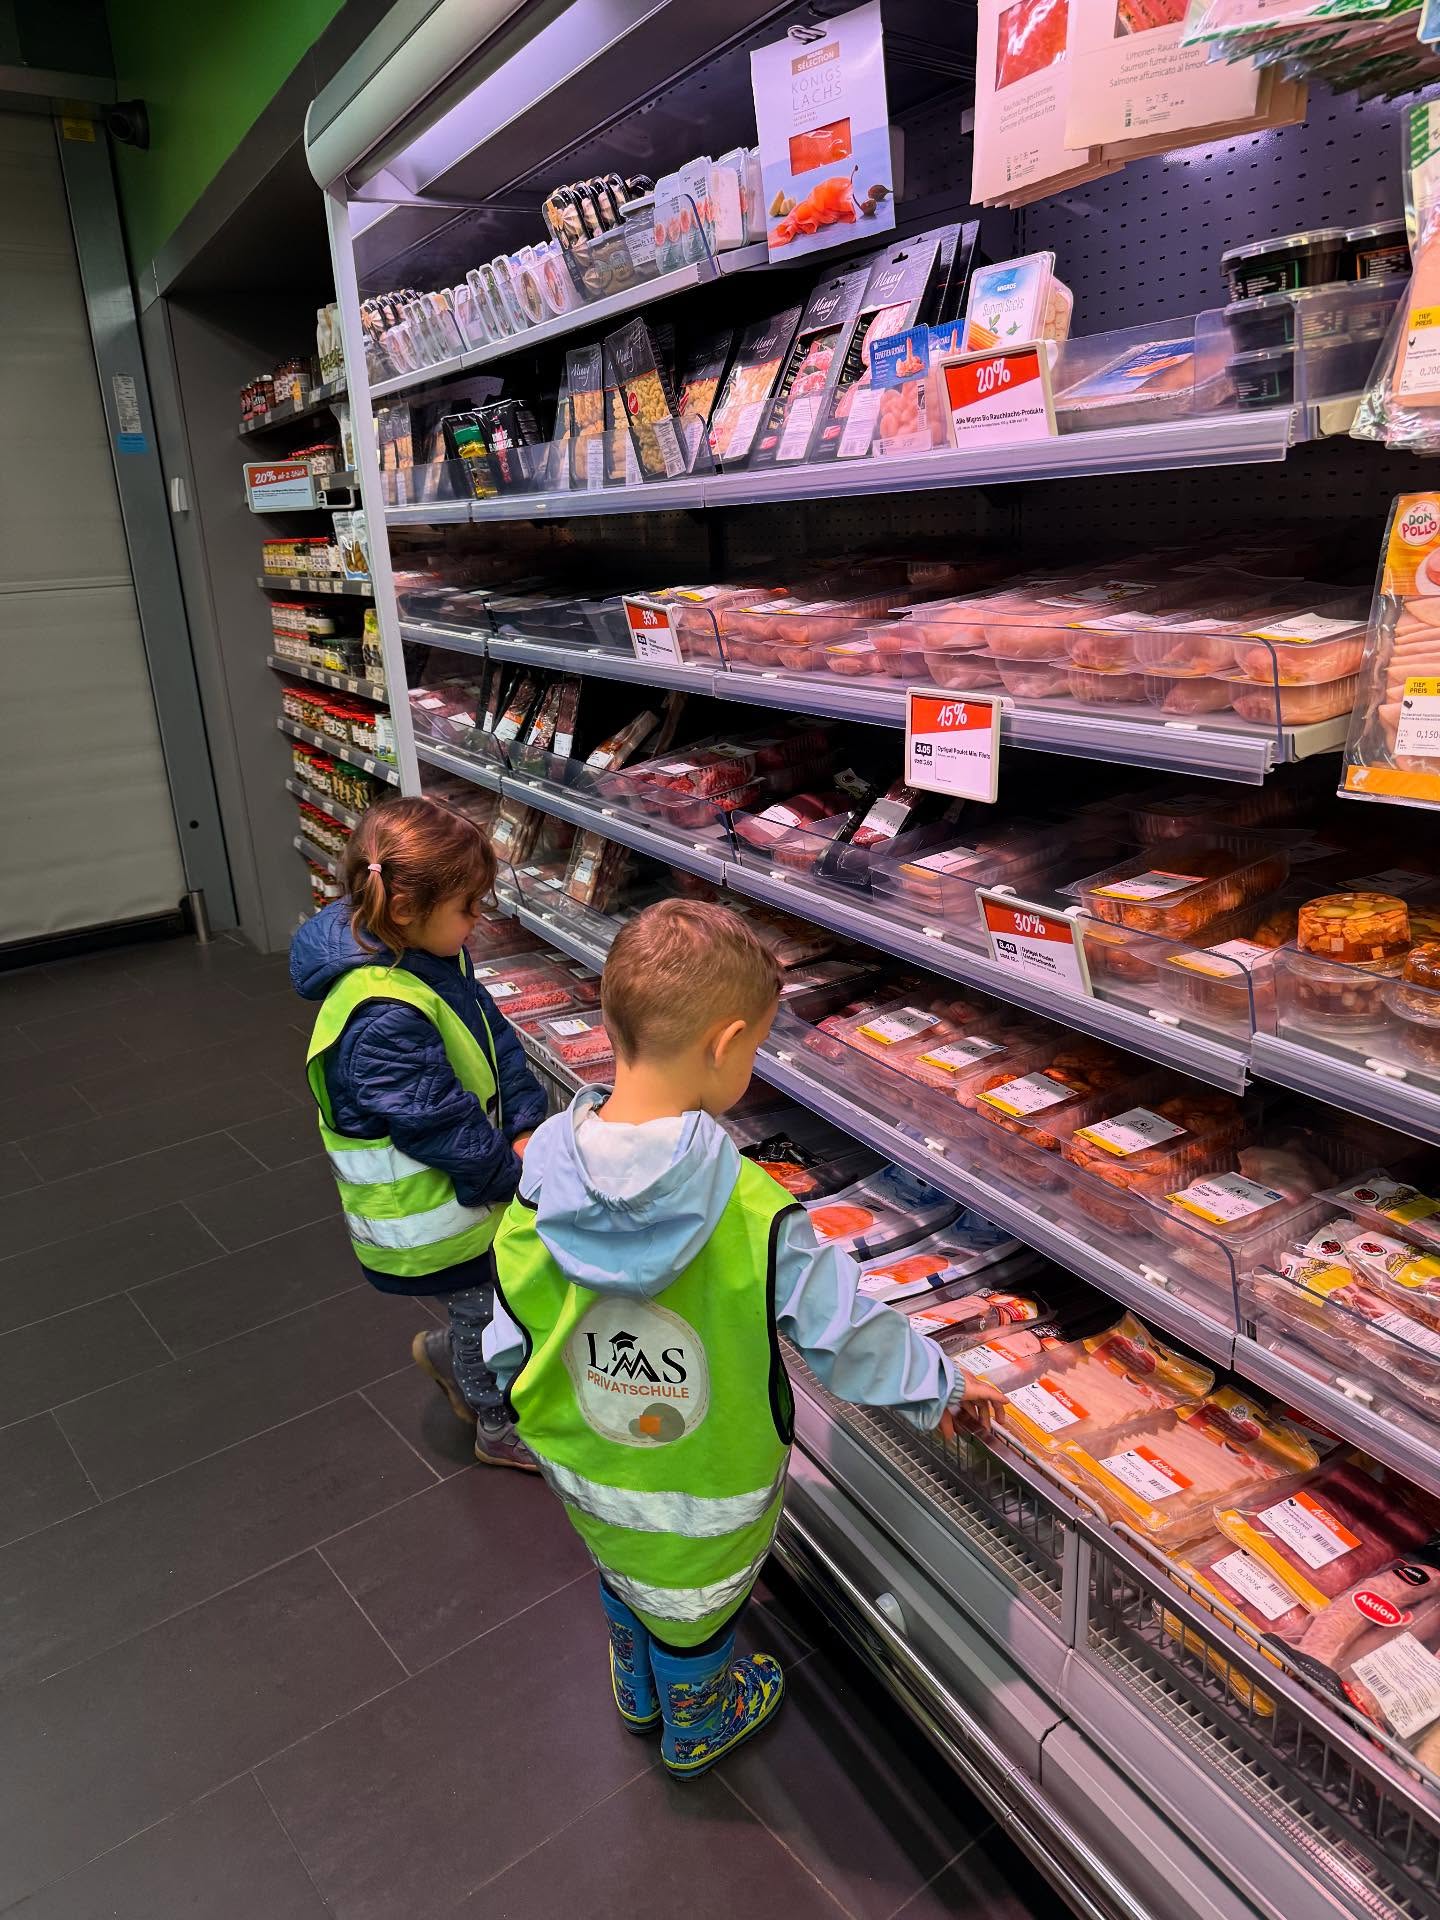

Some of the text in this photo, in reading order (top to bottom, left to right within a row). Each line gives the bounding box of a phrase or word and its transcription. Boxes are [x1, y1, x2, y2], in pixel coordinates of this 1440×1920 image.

[792, 80, 842, 111] LACHS
[976, 357, 1011, 394] 20%
[255, 470, 277, 484] 20%
[1402, 521, 1437, 539] POLLO
[1409, 513, 1432, 526] DON
[937, 702, 968, 727] 15%
[916, 744, 931, 755] 3.05
[1013, 912, 1046, 935] 30%
[587, 1369, 689, 1399] PRIVATSCHULE
[1357, 1593, 1396, 1623] Aktion
